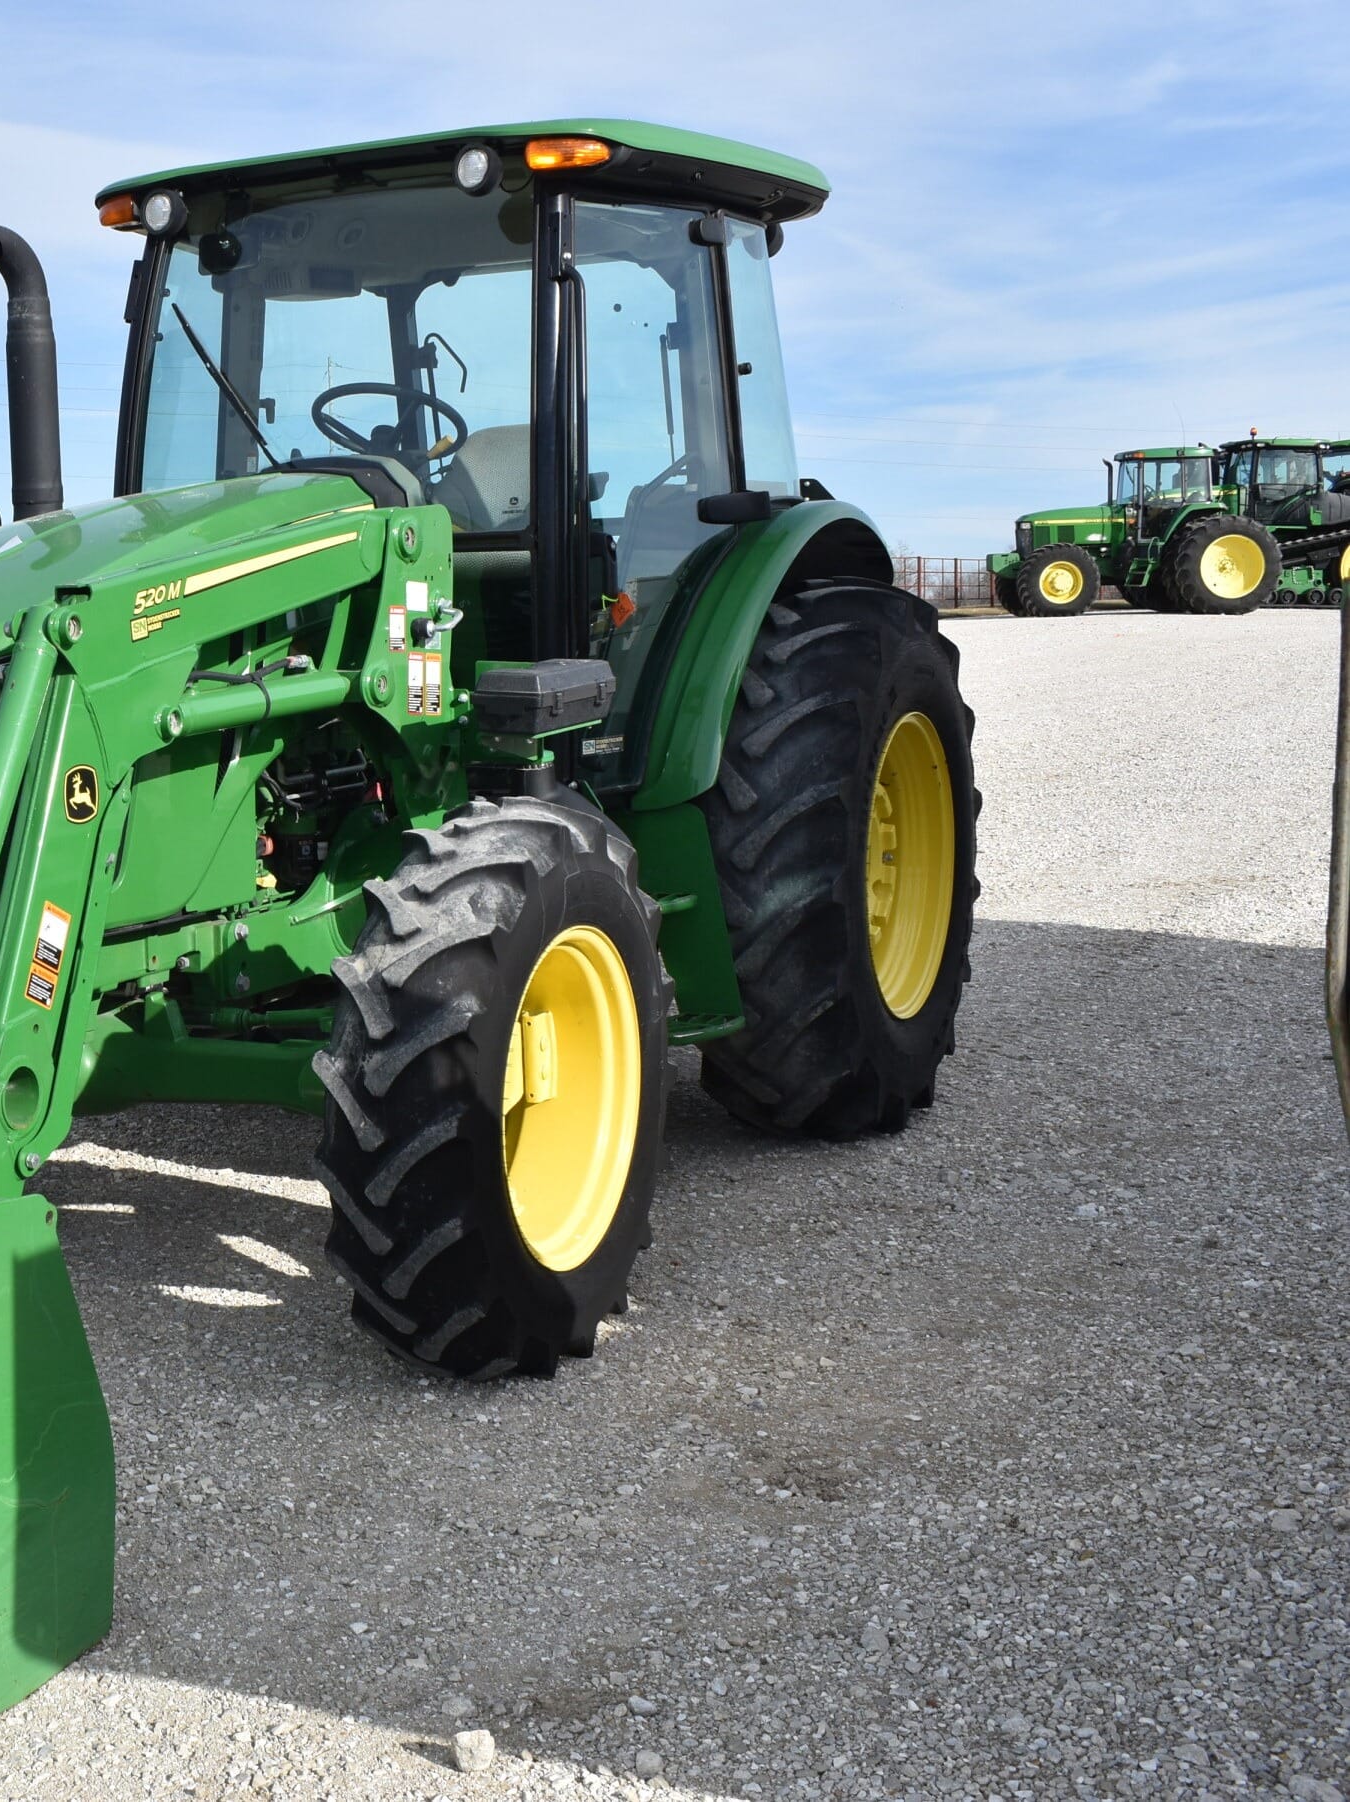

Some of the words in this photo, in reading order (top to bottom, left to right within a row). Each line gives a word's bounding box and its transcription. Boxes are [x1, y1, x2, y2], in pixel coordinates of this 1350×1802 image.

[133, 585, 167, 616] 520
[167, 579, 182, 601] M
[132, 619, 147, 634] SN
